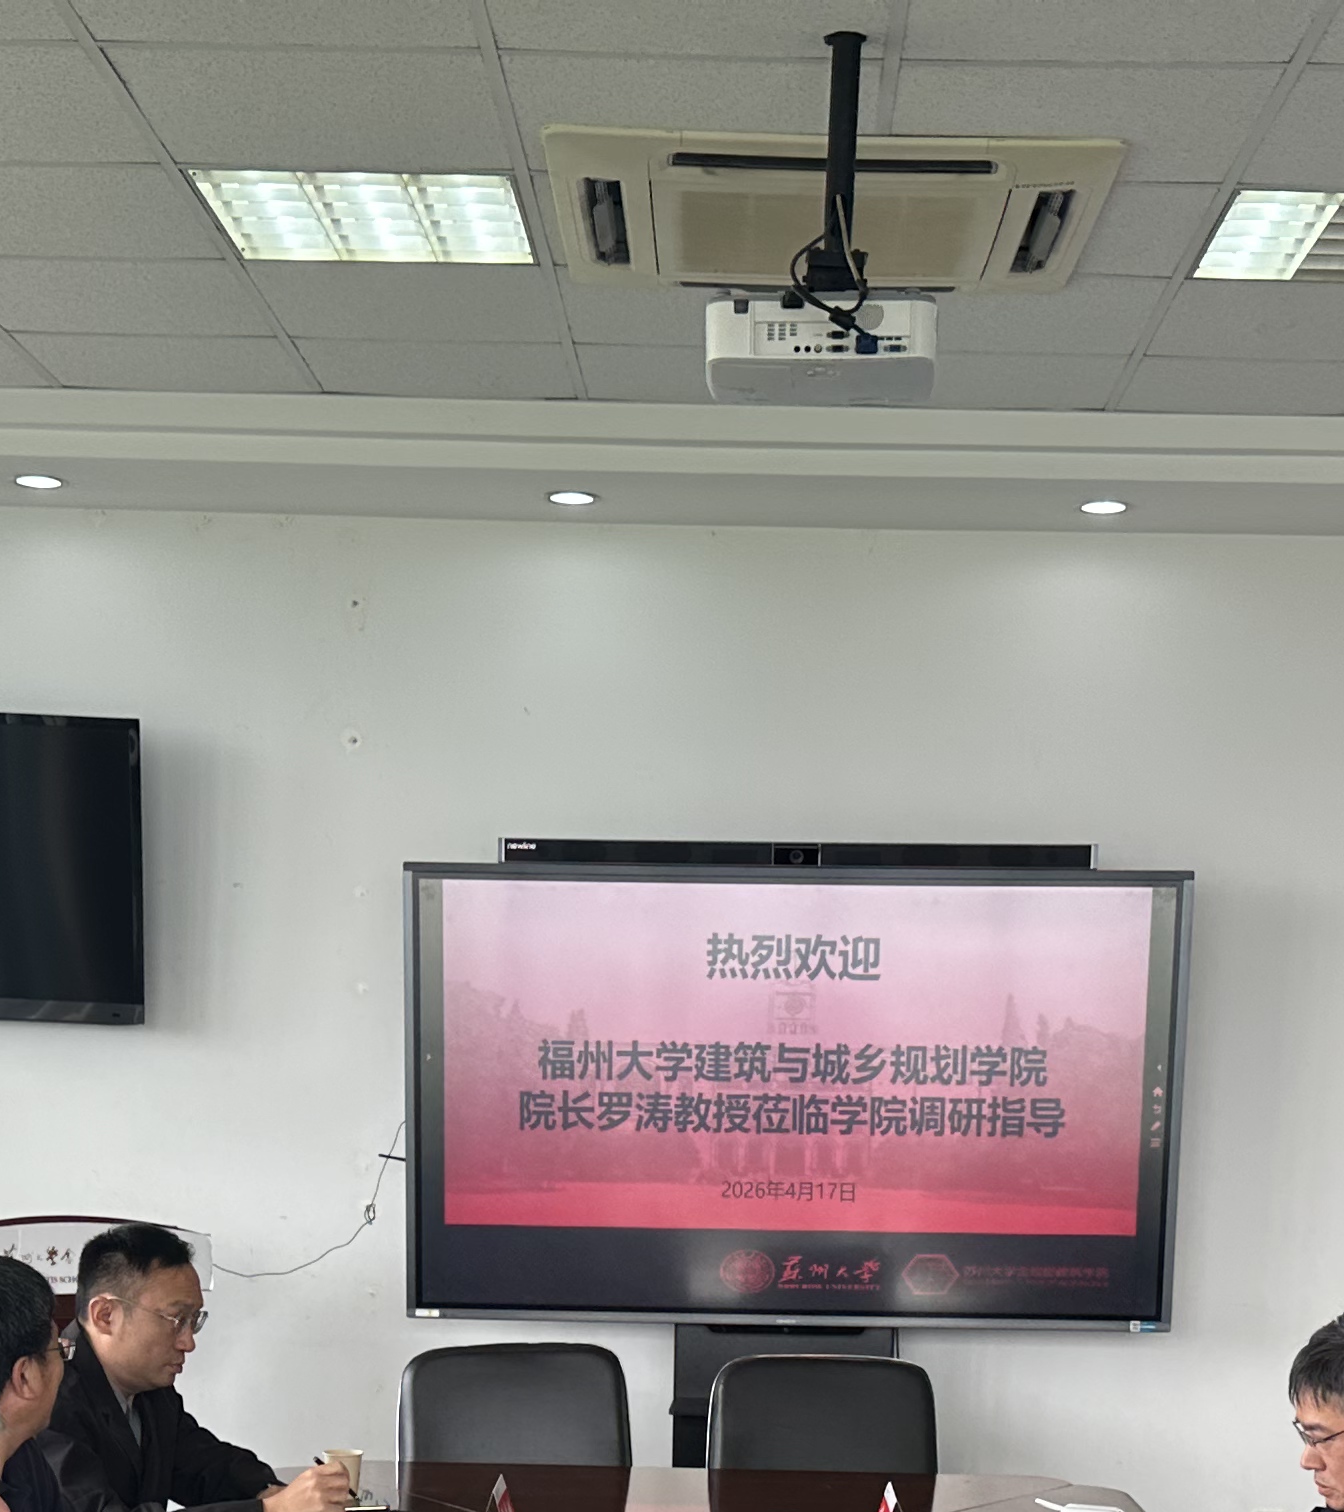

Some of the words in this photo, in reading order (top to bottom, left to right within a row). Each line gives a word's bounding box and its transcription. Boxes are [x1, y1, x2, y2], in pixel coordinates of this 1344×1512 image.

[706, 933, 882, 981] 热烈欢迎
[537, 1039, 1048, 1088] 福州大学建筑与城乡规划学院
[518, 1090, 1066, 1138] 院长罗涛教授莅临学院调研指导
[720, 1179, 856, 1203] 2026年4月17日
